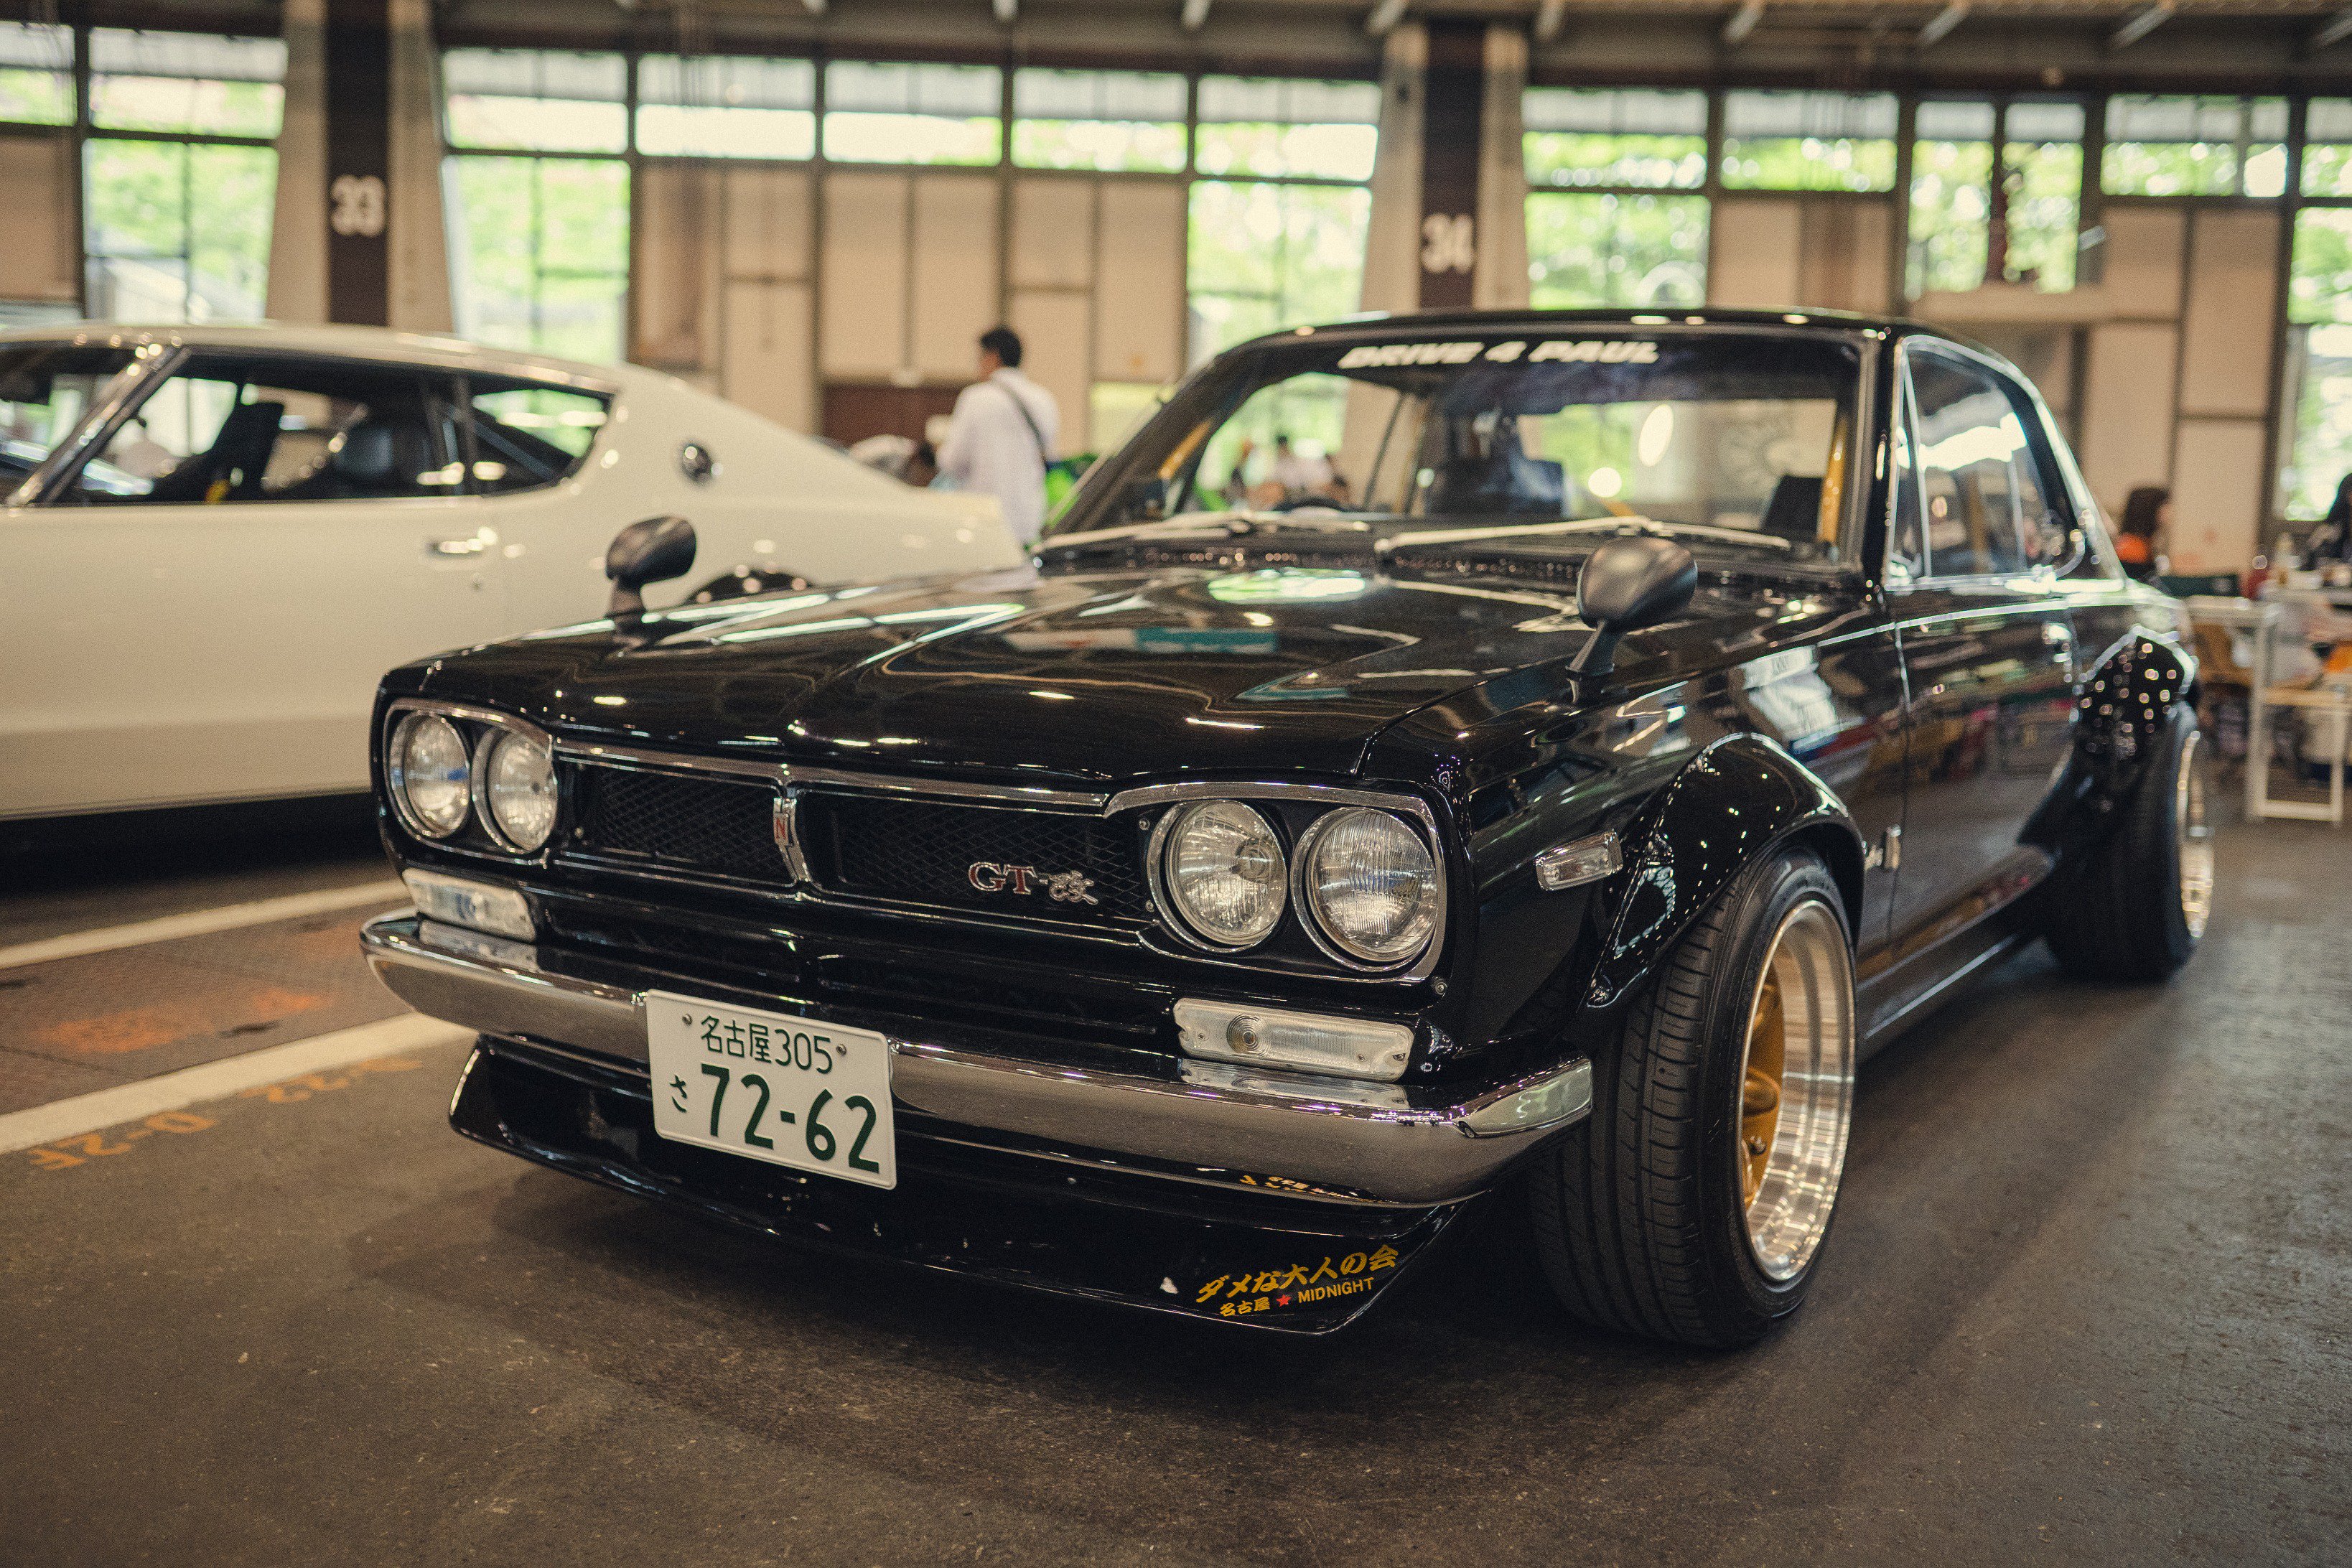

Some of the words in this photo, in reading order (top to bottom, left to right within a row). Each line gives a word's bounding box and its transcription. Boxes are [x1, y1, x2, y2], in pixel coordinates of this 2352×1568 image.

[1338, 341, 1485, 369] DRIVE
[1484, 340, 1527, 363] 4
[1528, 340, 1660, 363] PAUL
[669, 1074, 688, 1114] さ
[700, 1063, 880, 1174] 72-62
[1195, 1244, 1399, 1303] ダメな大人の会
[1219, 1297, 1271, 1317] 名古屋
[1298, 1277, 1375, 1304] MIDNIGHT
